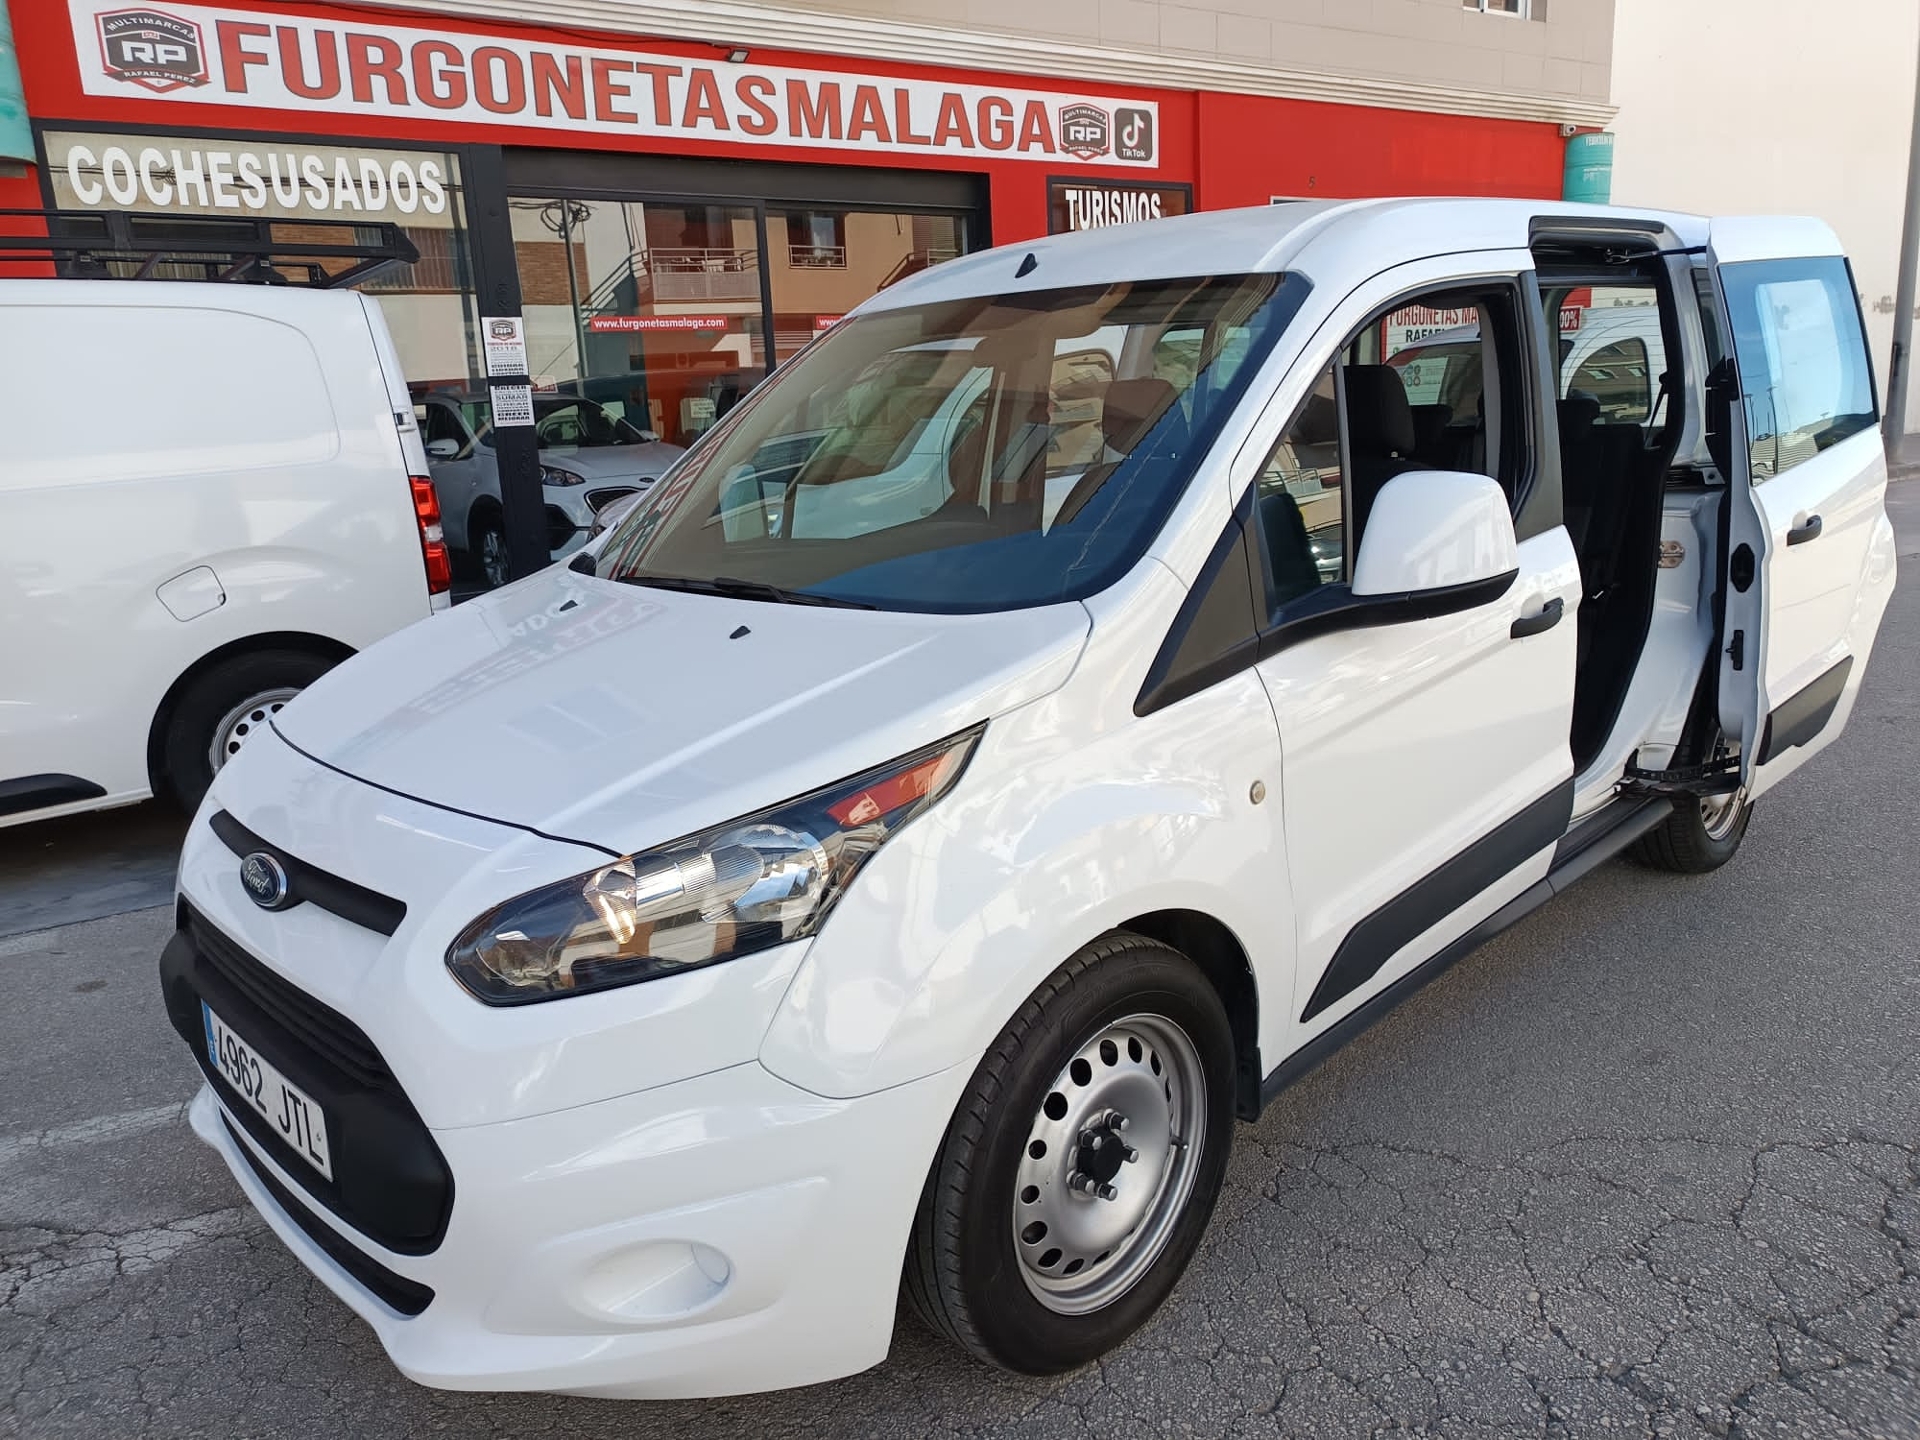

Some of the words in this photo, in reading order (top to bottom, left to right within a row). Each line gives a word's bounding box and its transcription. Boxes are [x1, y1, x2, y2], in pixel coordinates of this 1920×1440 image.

[107, 17, 195, 39] MULTIMARCAS
[121, 40, 188, 64] RP
[164, 72, 197, 83] PEREZ
[215, 19, 1056, 154] FURGONETASMALAGA
[1069, 125, 1101, 142] RP
[1122, 148, 1146, 158] TikTok
[67, 145, 446, 214] COCHESUSADOS
[1065, 189, 1161, 230] TURISMOS
[594, 317, 725, 330] www.furgonetasmalaga.com
[246, 859, 271, 893] Ford
[218, 1025, 268, 1114] 4962
[277, 1083, 325, 1167] JTL
